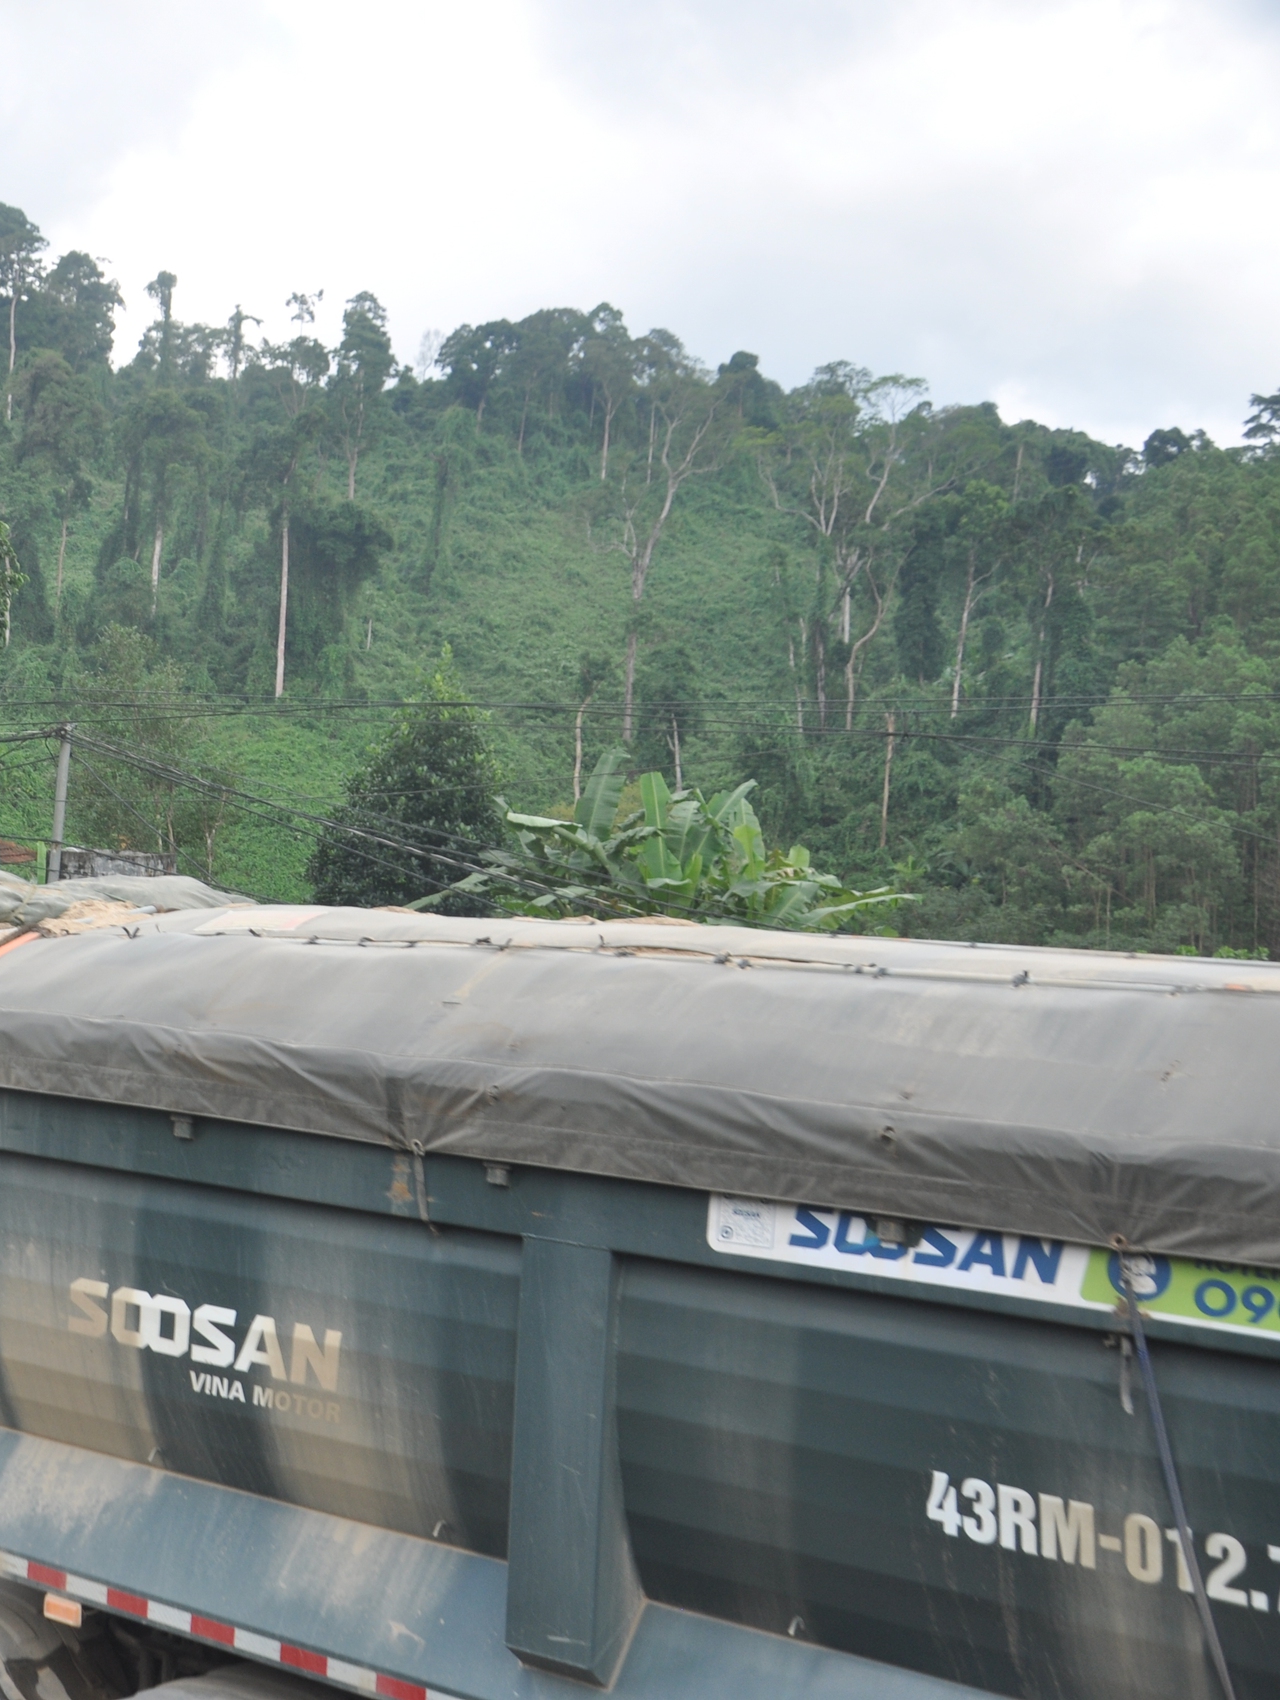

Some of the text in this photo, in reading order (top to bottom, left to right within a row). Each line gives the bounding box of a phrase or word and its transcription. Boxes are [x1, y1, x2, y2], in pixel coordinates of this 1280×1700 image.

[1194, 1278, 1280, 1323] 09
[70, 1277, 343, 1392] SOOSAN
[189, 1370, 341, 1424] VINA MOTOR
